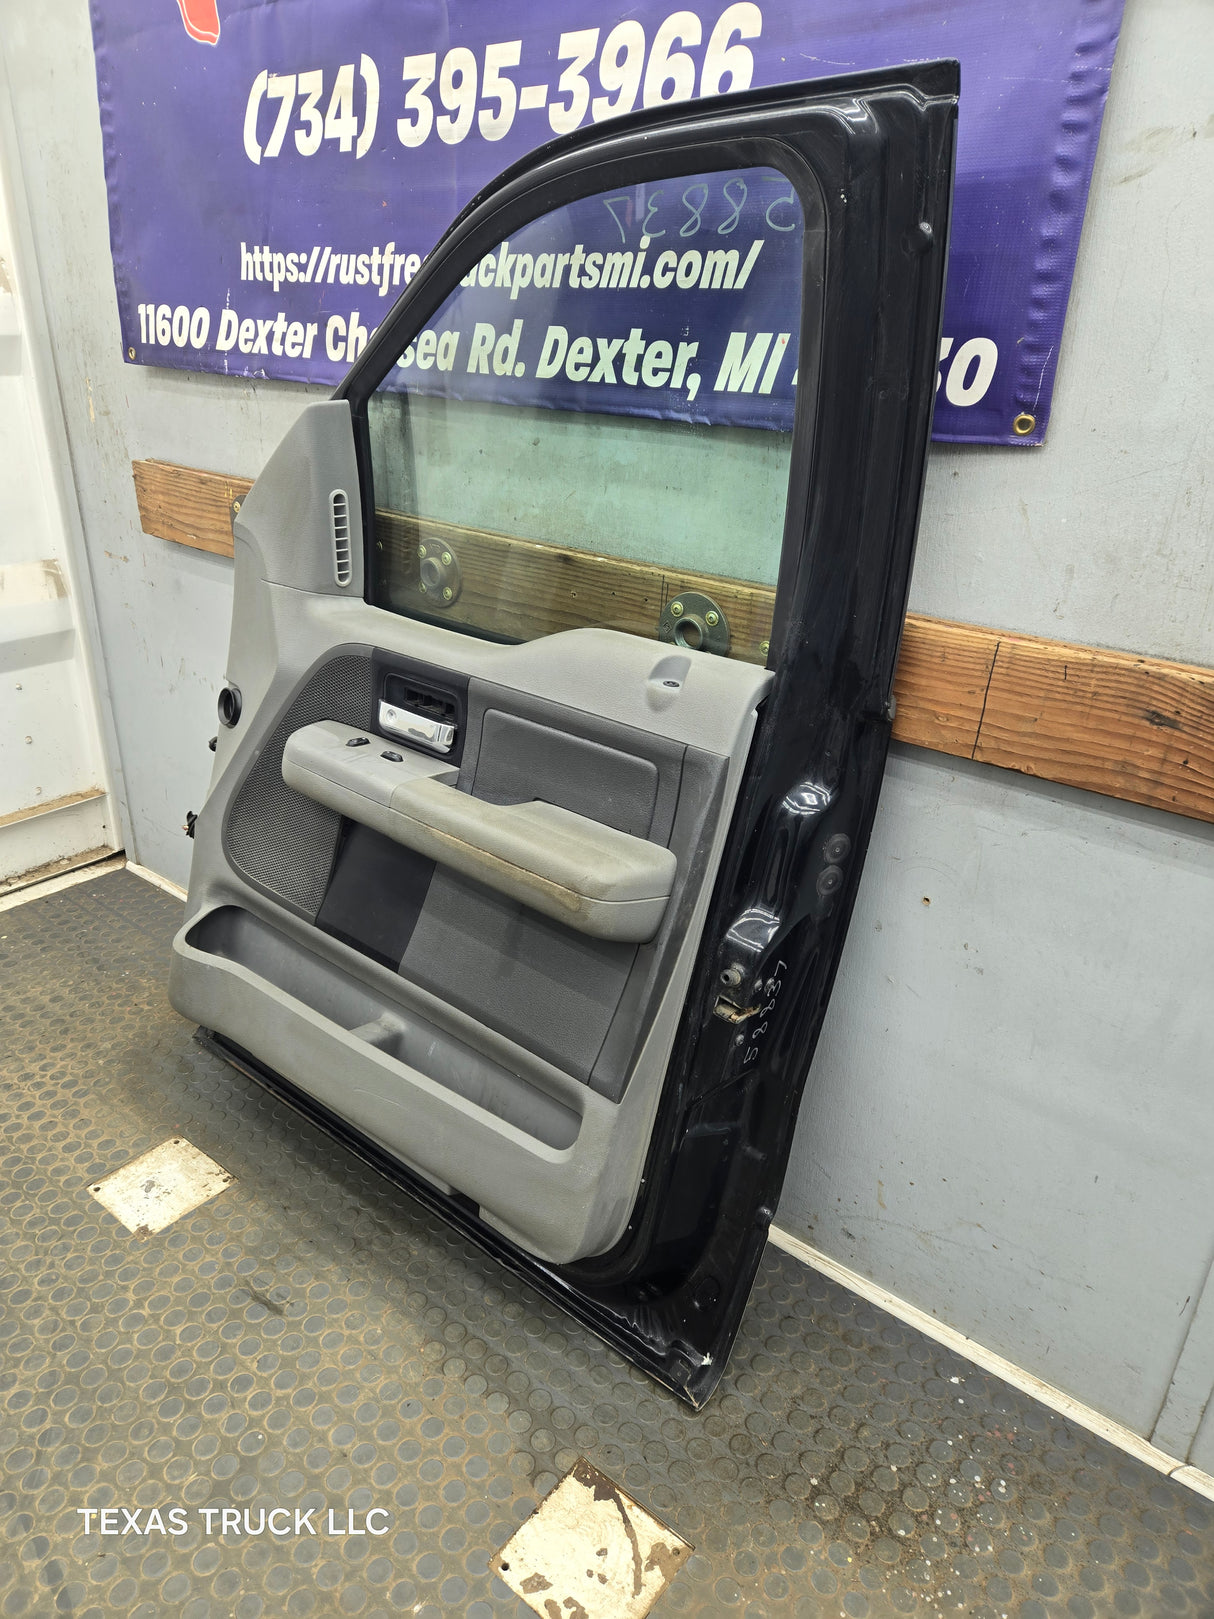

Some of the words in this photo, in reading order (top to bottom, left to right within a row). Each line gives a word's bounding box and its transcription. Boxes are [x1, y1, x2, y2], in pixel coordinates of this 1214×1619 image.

[243, 53, 380, 165] (734)
[397, 2, 763, 148] 395-3966
[240, 236, 765, 300] https://rustfreckpartsmi.com/
[137, 304, 211, 350] 11600
[215, 308, 318, 359] Dexter
[325, 311, 460, 371] Chsea
[466, 318, 526, 378] Rd.
[535, 325, 702, 401] Dexter,
[713, 331, 791, 394] MI
